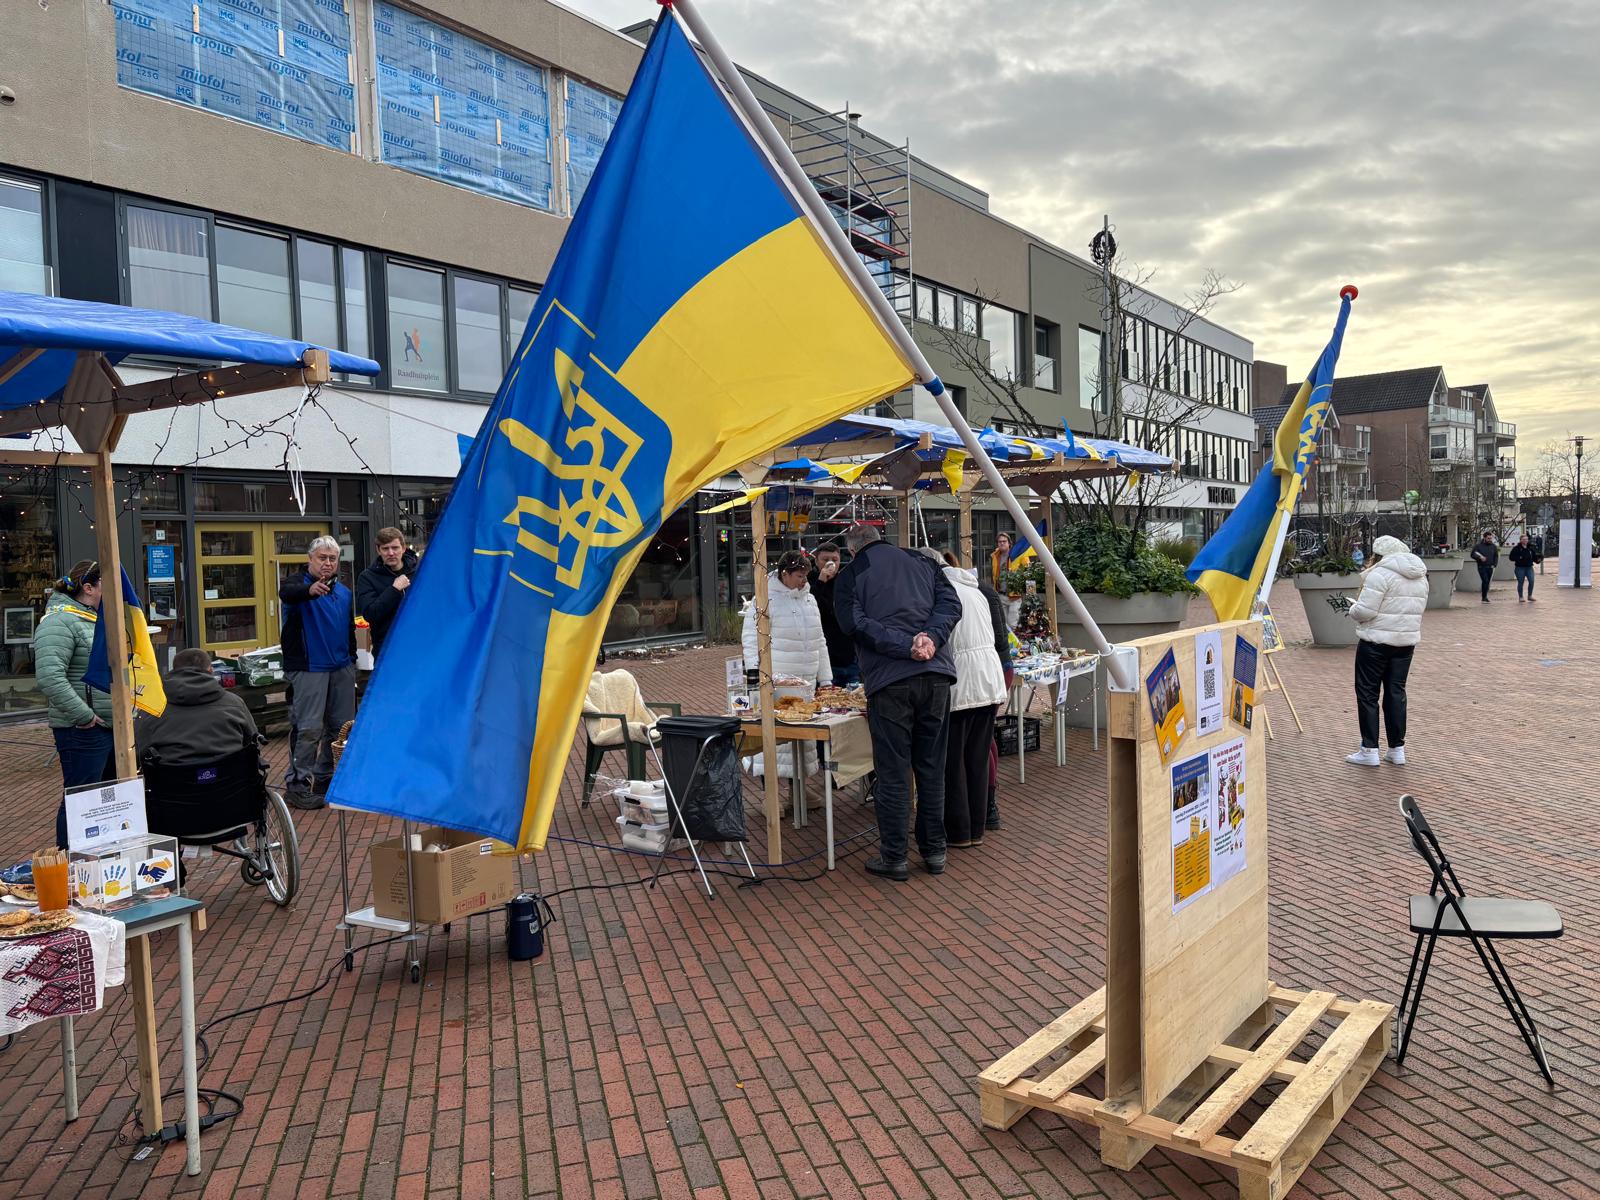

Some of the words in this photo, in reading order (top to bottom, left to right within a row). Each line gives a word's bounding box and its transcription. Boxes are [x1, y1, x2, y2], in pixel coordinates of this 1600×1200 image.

[297, 22, 335, 43] miofol
[191, 34, 234, 55] miofol
[418, 38, 450, 57] miofol
[136, 68, 159, 80] 125G
[181, 69, 225, 90] miofol
[268, 61, 307, 80] miofol
[411, 68, 444, 88] miofol
[475, 62, 504, 79] miofol
[259, 95, 300, 114] miofol
[469, 89, 499, 108] miofol
[386, 101, 420, 118] miofol
[445, 121, 477, 138] miofol
[441, 150, 473, 168] miofol
[494, 168, 523, 184] miofol
